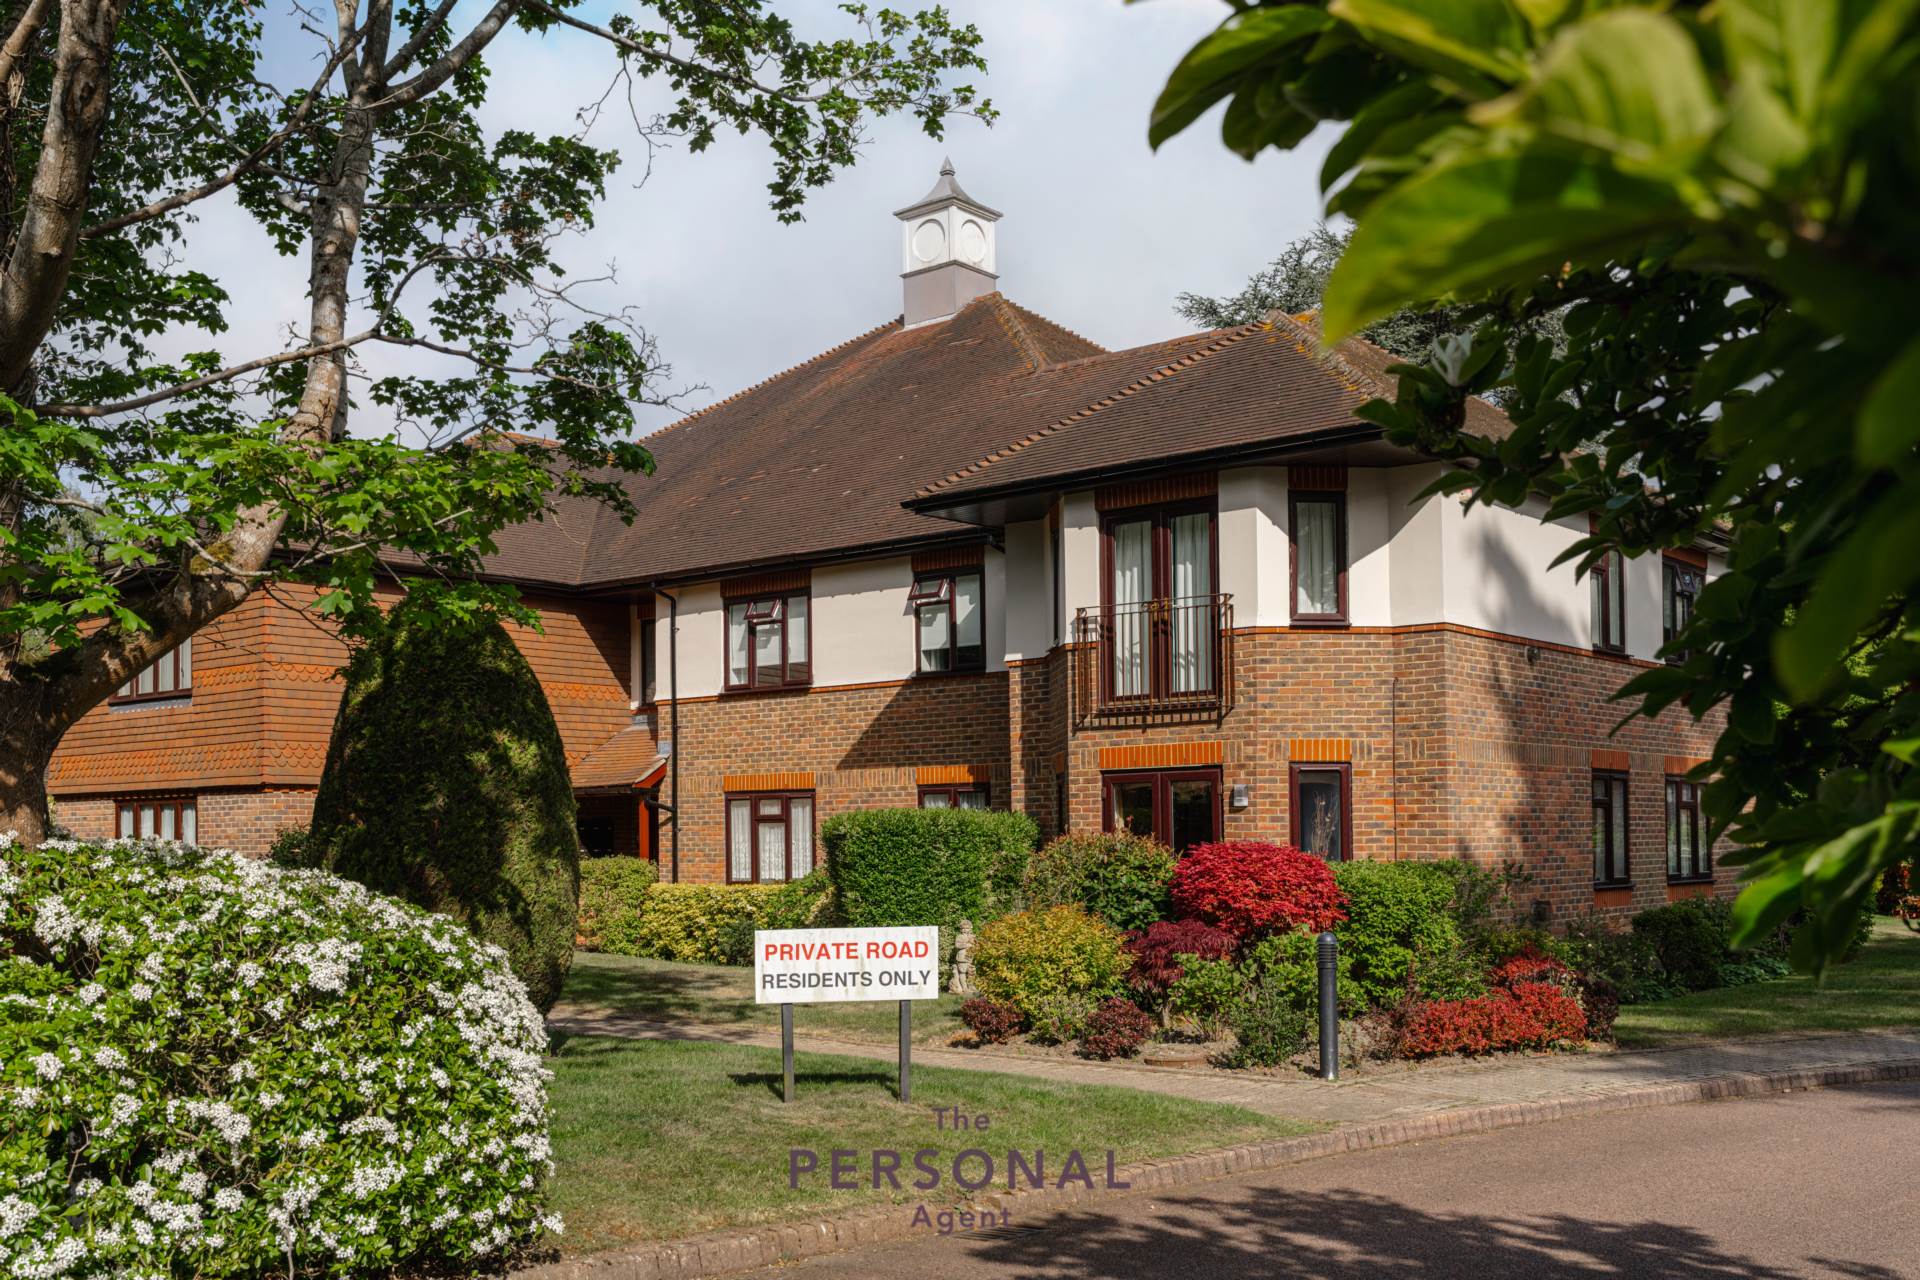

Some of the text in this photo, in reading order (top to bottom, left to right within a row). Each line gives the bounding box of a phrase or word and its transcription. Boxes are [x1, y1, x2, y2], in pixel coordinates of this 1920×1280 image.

[764, 941, 929, 961] PRIVATE ROAD
[762, 970, 931, 989] RESIDENTS ONLY
